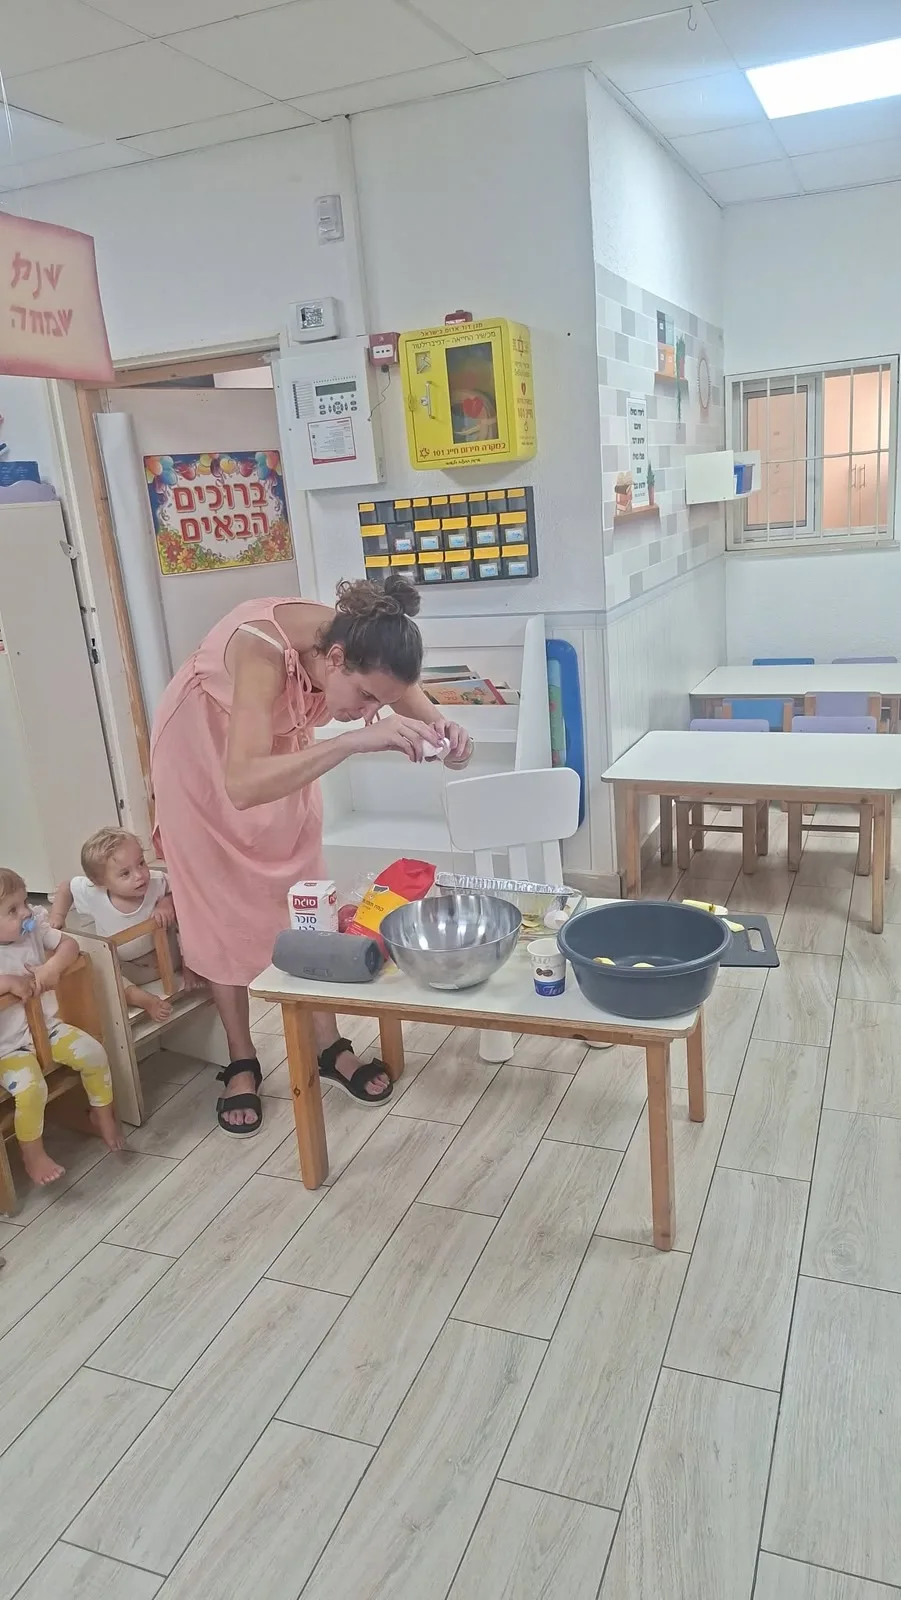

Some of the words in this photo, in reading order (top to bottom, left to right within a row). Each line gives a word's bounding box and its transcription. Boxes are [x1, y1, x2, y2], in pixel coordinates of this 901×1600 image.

[11, 251, 64, 299] שנת
[9, 304, 73, 337] שמחה
[448, 447, 459, 455] חייג
[461, 445, 480, 454] חירום
[482, 442, 506, 452] במקרה
[433, 449, 444, 457] 101
[173, 482, 268, 513] ברוכים
[180, 512, 270, 544] הבאים
[294, 897, 317, 908] סוגת
[295, 915, 317, 924] סוכר
